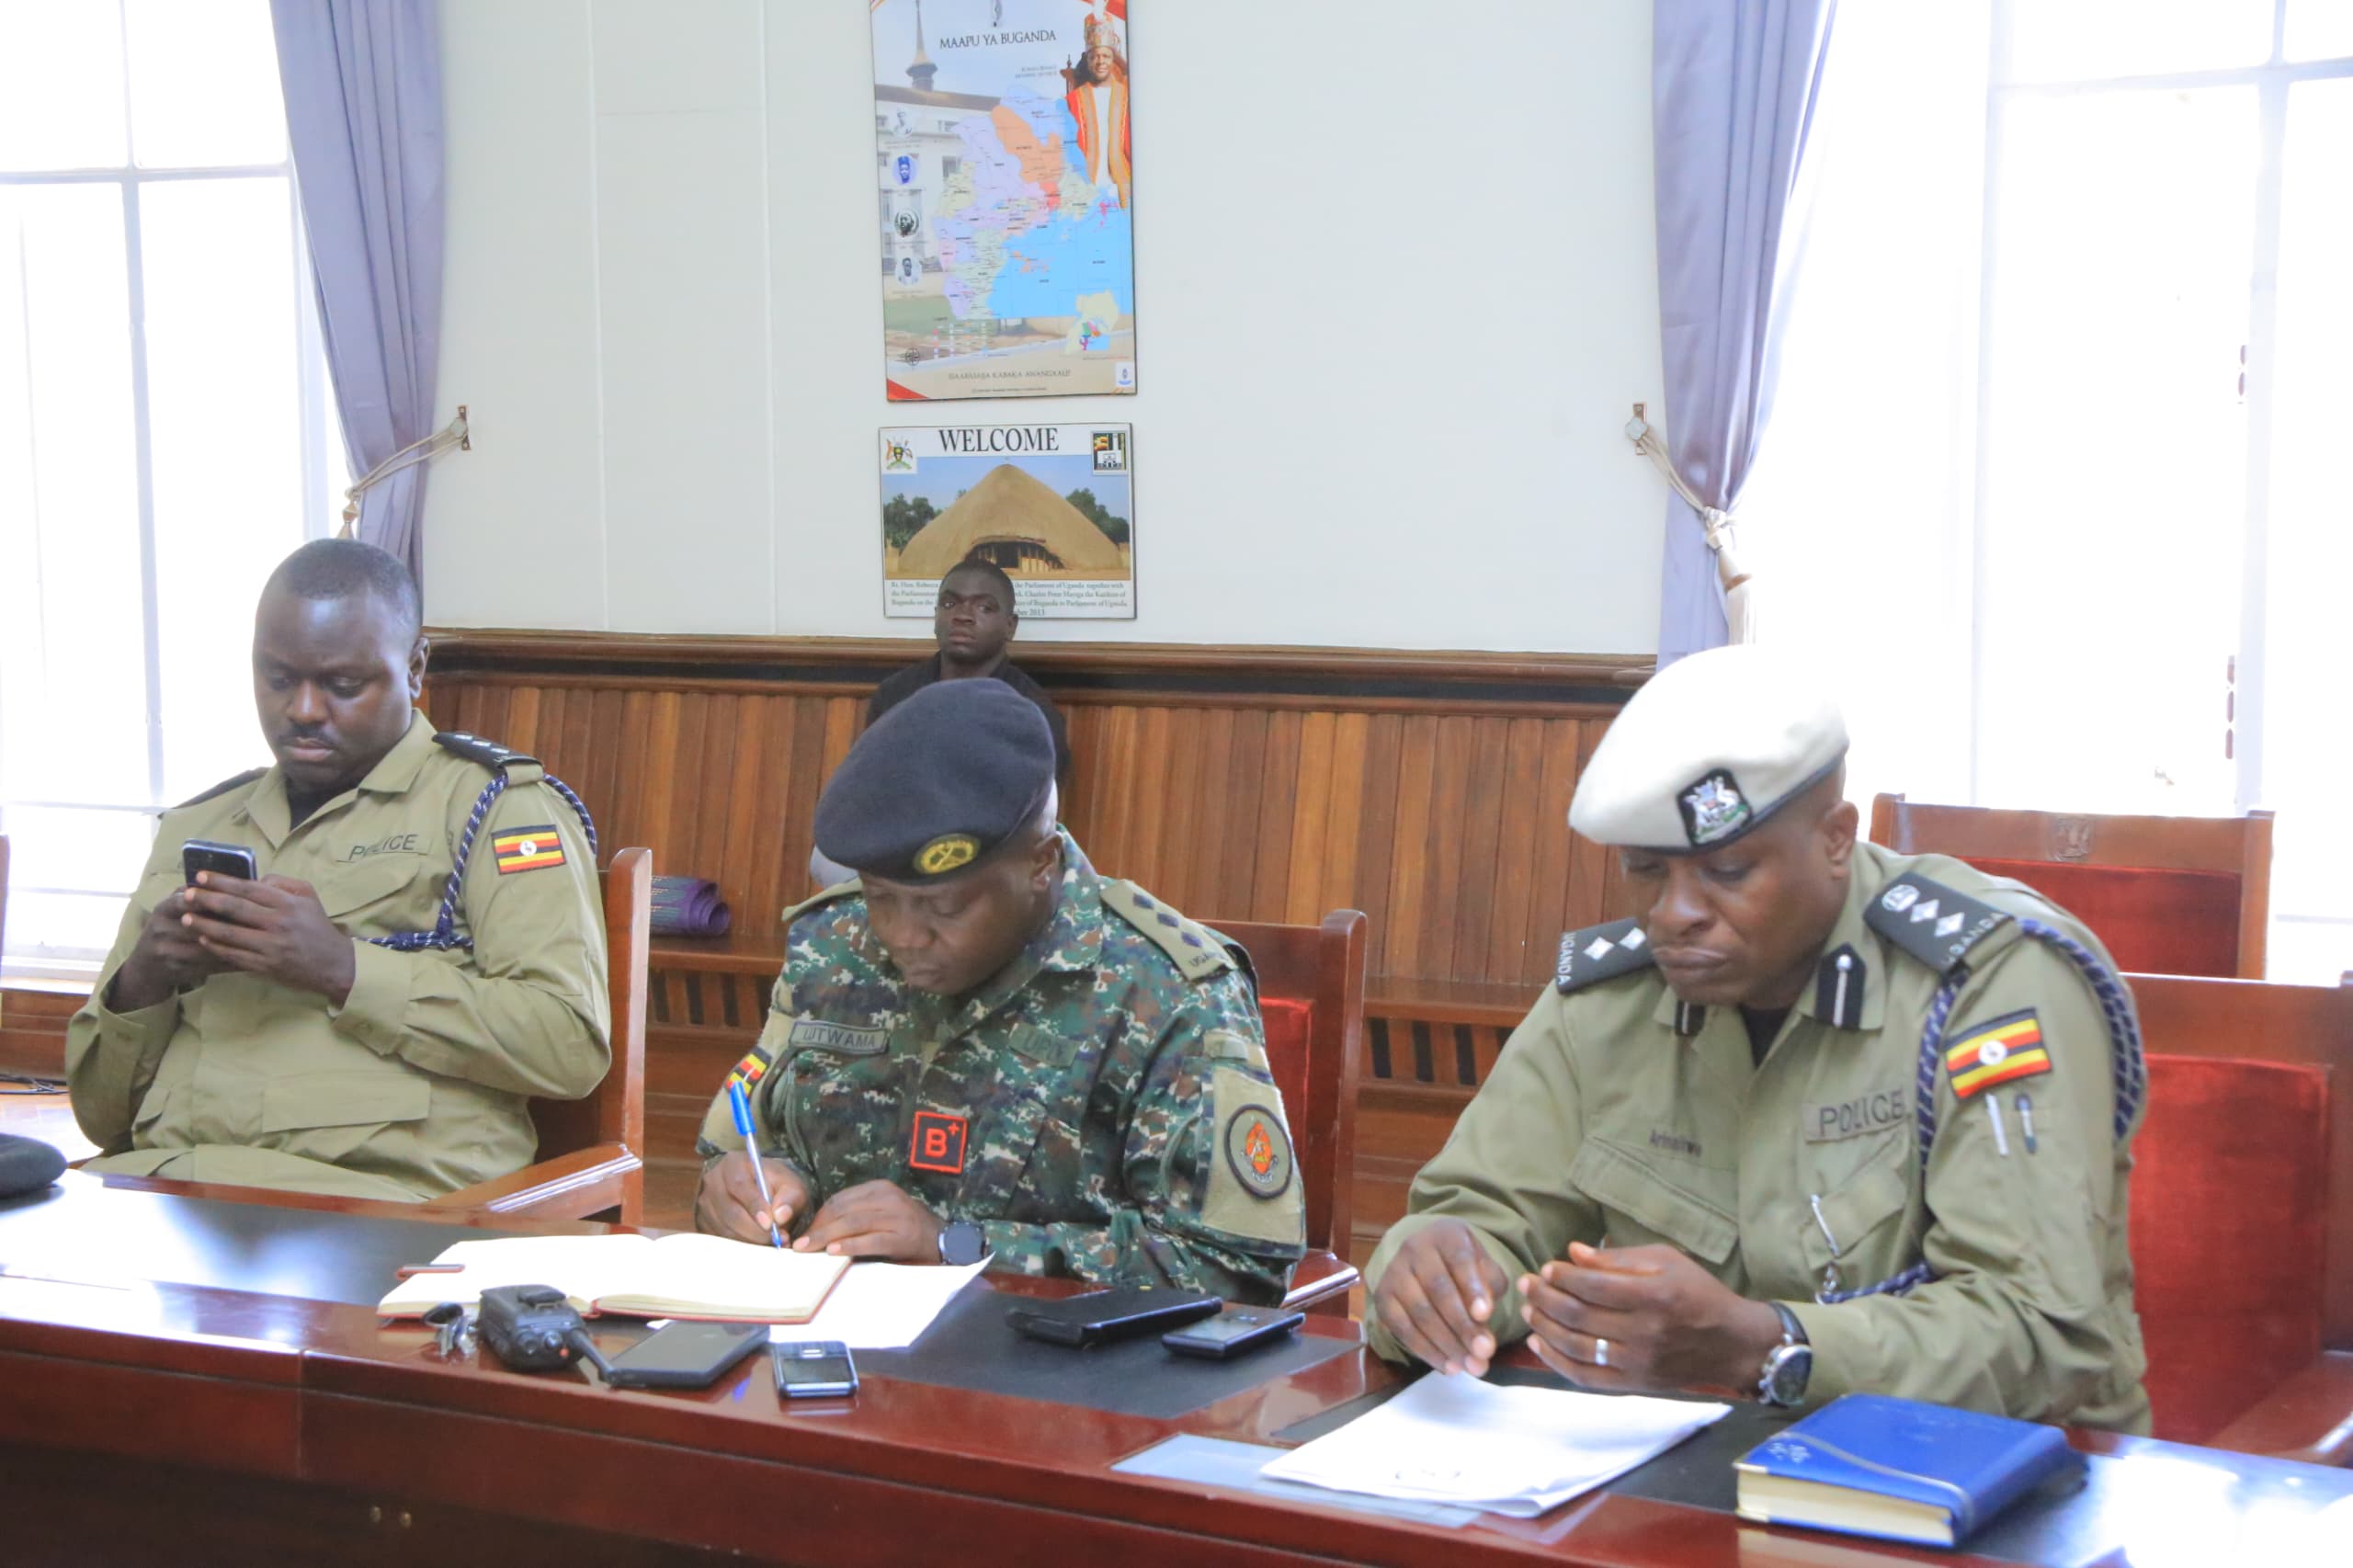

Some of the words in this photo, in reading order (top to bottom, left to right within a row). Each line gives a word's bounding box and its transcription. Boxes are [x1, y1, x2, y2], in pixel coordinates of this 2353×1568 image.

[939, 35, 980, 49] MAAPU
[982, 34, 997, 46] YA
[1001, 29, 1057, 44] BUGANDA
[938, 427, 1060, 452] WELCOME
[1558, 932, 1576, 985] UGANDA
[1941, 911, 2007, 965] UGANDA
[1819, 1088, 1904, 1137] POLICE
